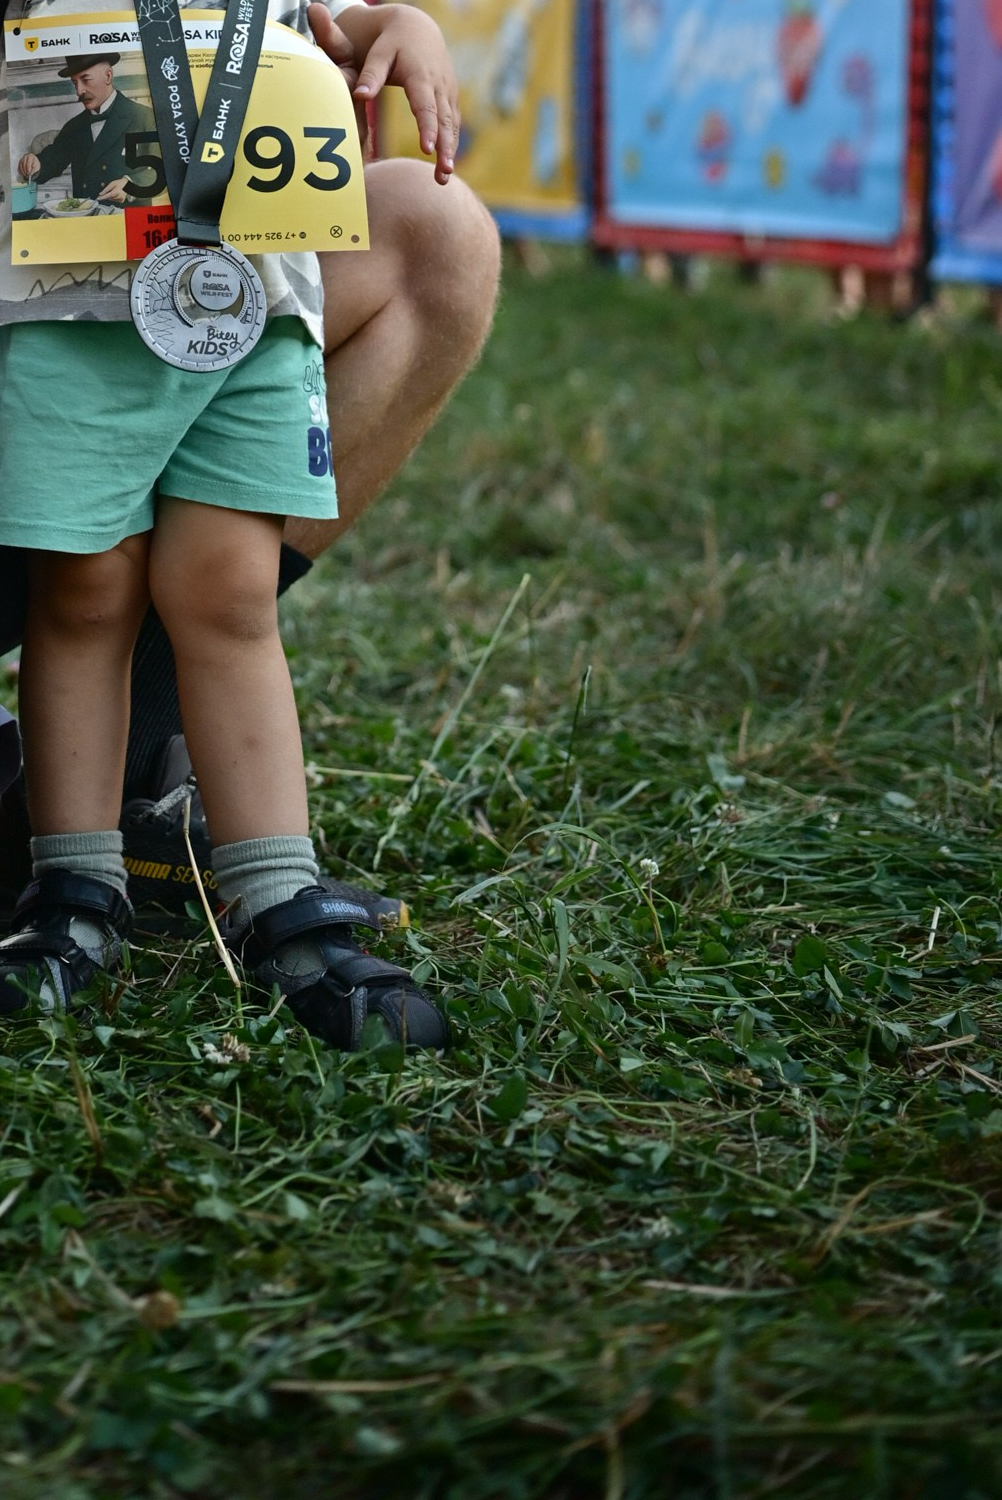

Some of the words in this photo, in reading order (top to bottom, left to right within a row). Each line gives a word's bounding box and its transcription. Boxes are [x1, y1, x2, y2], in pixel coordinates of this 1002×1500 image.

[237, 0, 247, 20] WILD
[244, 2, 254, 22] FEST
[41, 38, 70, 47] БАНК
[89, 32, 131, 44] ROSA
[184, 30, 202, 39] SA
[225, 23, 251, 74] ROSA
[168, 85, 183, 119] РОЗА
[212, 98, 231, 140] БАНК
[174, 122, 191, 164] ХУТОР
[122, 126, 352, 198] 593
[228, 233, 241, 242] 00
[243, 233, 262, 241] 444
[265, 232, 283, 241] 925
[284, 232, 296, 240] +7
[202, 283, 230, 291] ROSA
[206, 328, 240, 348] Bitey
[186, 340, 228, 356] KIDS
[123, 857, 172, 880] PUMA
